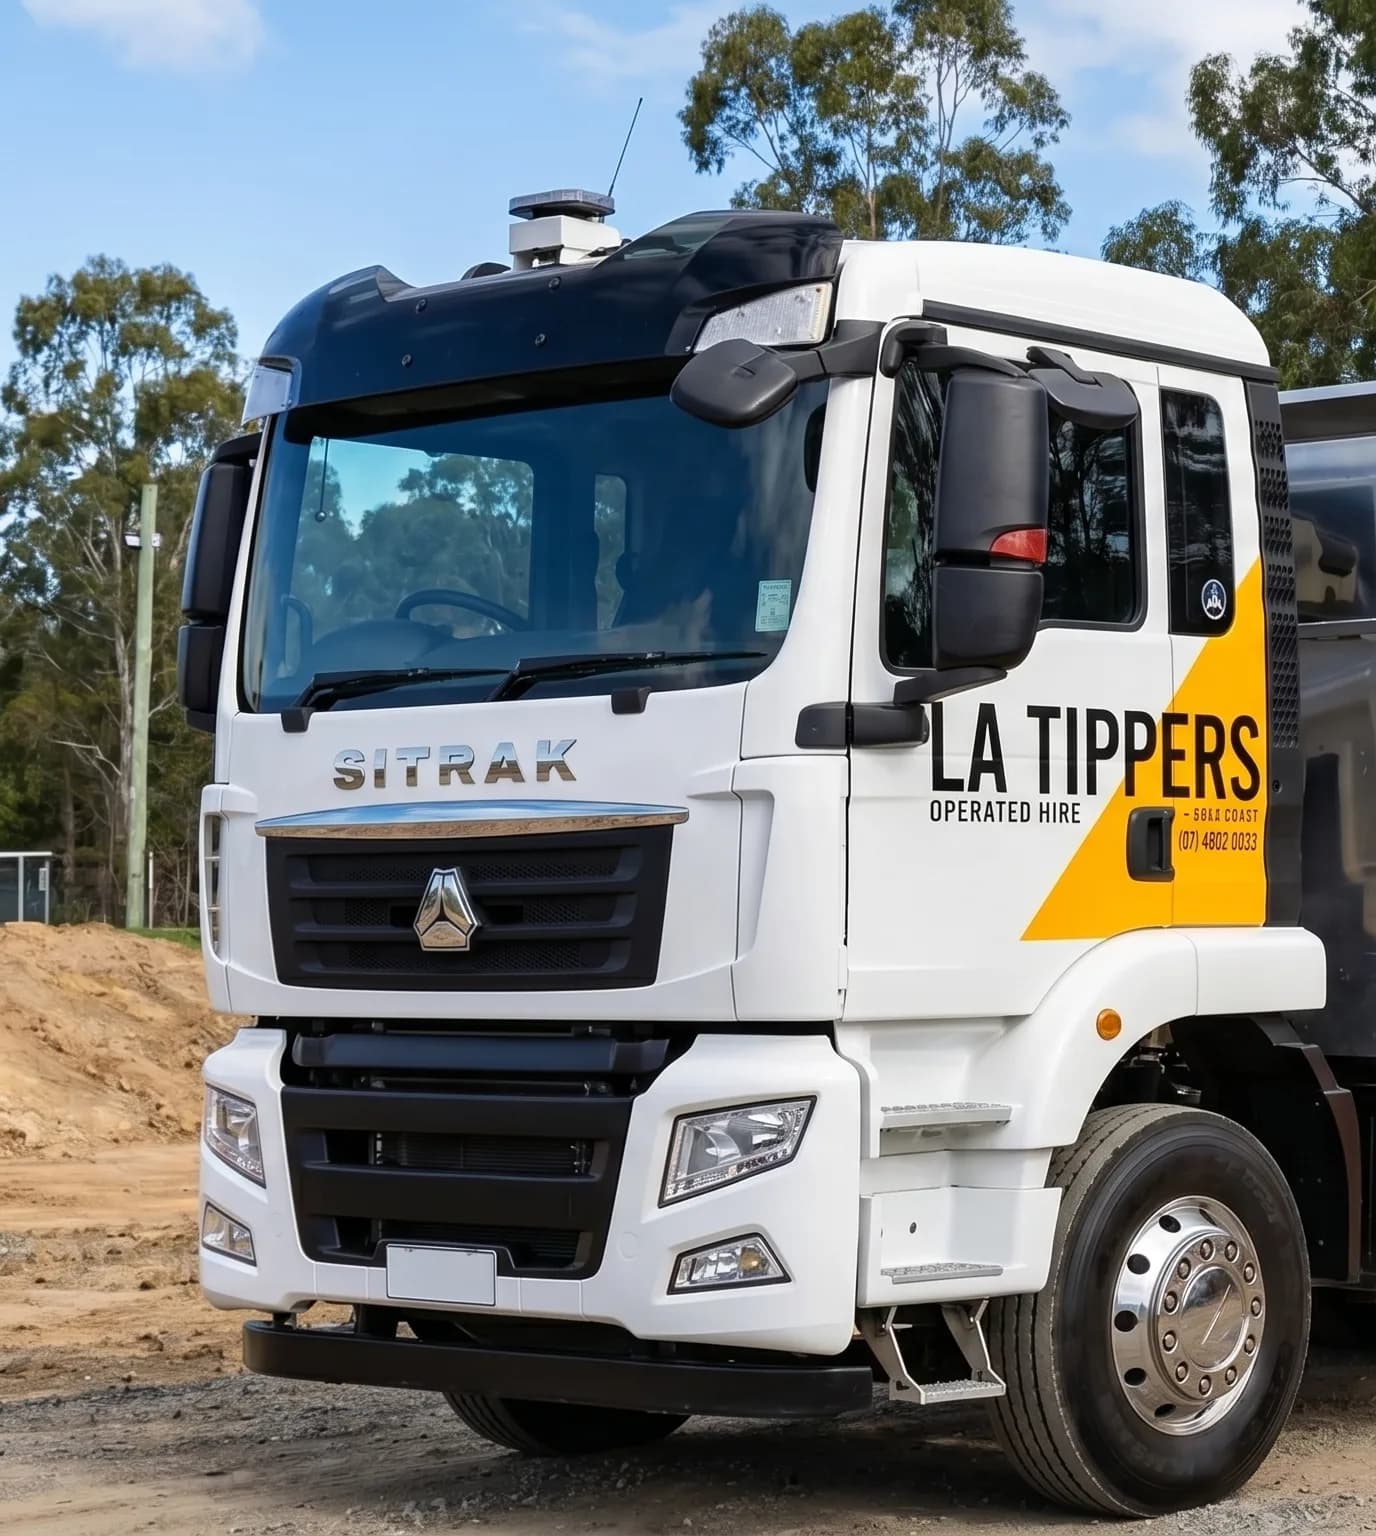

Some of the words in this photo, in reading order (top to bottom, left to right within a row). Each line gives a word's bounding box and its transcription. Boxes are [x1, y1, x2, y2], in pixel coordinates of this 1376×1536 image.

[333, 739, 577, 790] SITRAK
[931, 701, 1008, 794] LA
[1026, 705, 1261, 801] TIPPERS
[930, 799, 1031, 824] OPERATED
[1039, 802, 1081, 825] HIRE
[1224, 808, 1259, 823] COAST
[1179, 830, 1199, 853] (07)
[1202, 831, 1229, 851] 4802
[1231, 832, 1258, 851] 0033
